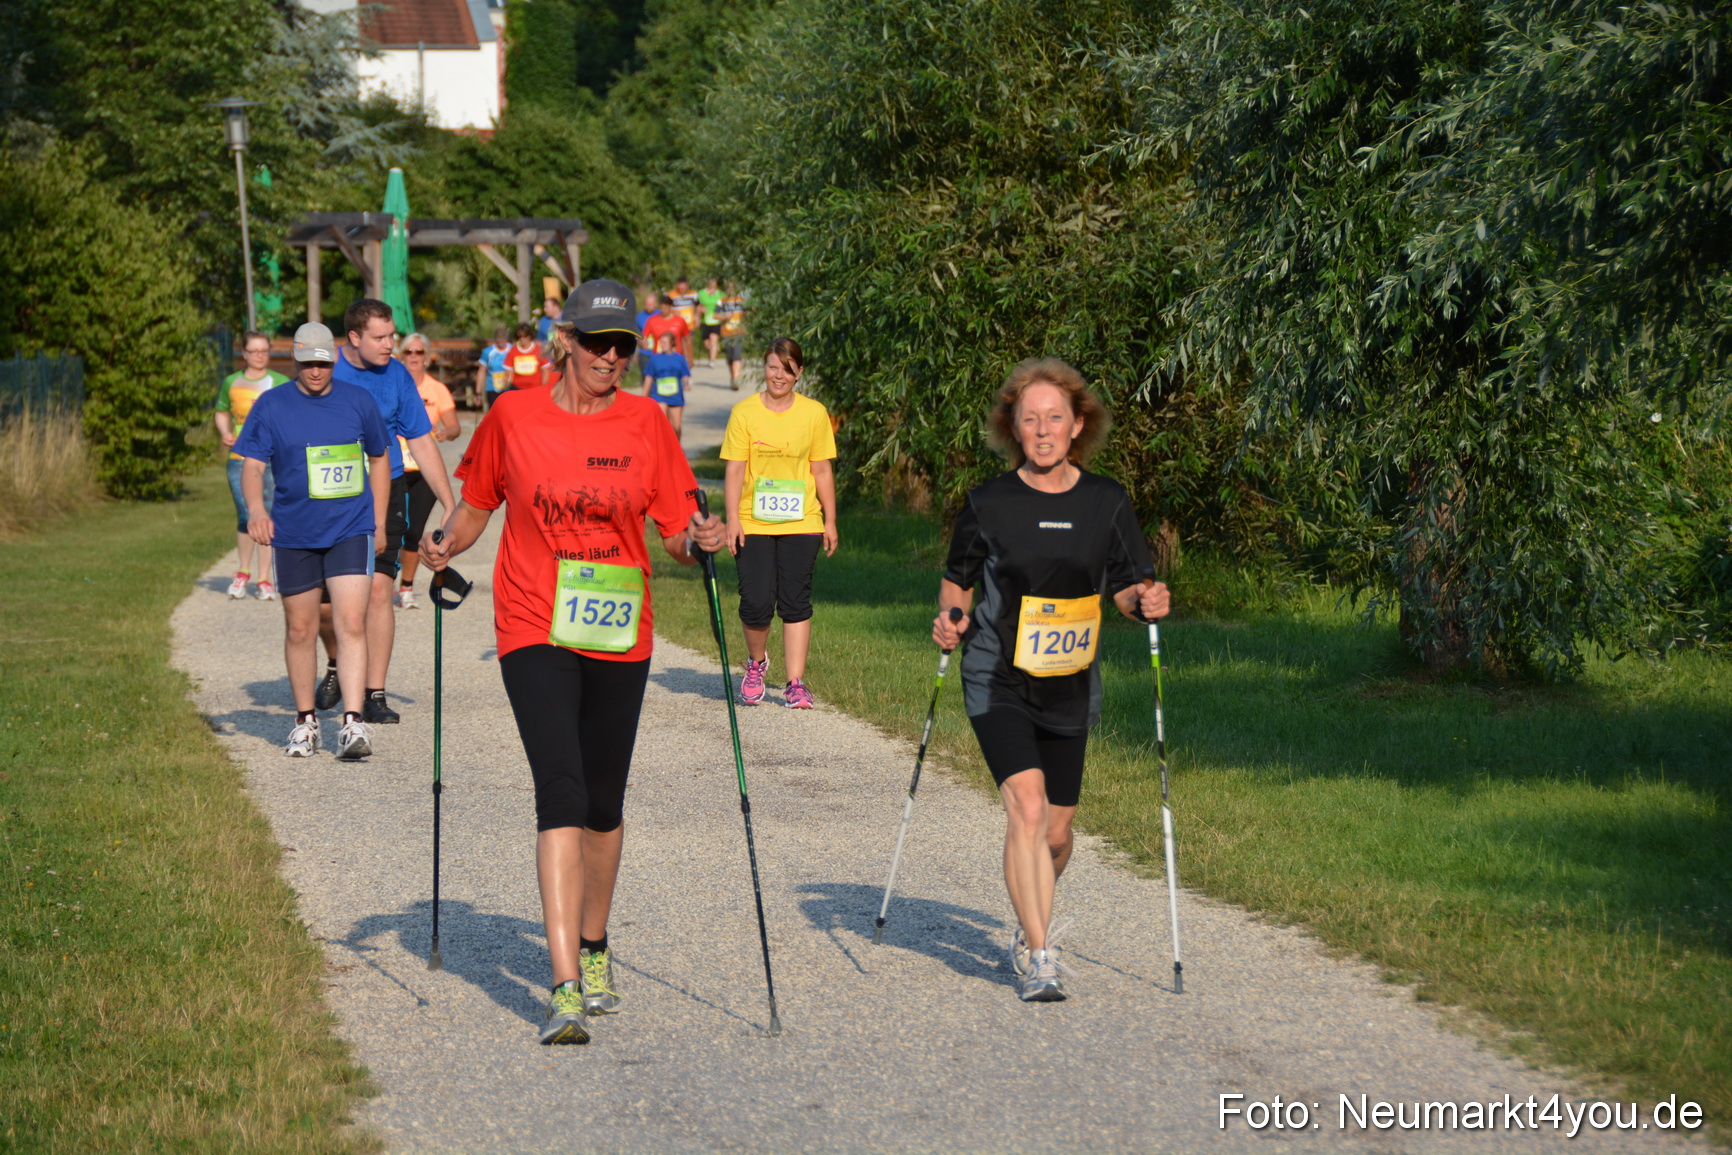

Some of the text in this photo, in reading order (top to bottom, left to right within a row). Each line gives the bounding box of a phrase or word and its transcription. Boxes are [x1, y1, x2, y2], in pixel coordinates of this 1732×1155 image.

[593, 297, 620, 305] swn
[587, 457, 618, 467] swn
[320, 466, 353, 484] 787
[759, 496, 800, 513] 1332
[589, 545, 620, 560] läuft
[566, 596, 632, 628] 1523
[1028, 627, 1090, 655] 1204
